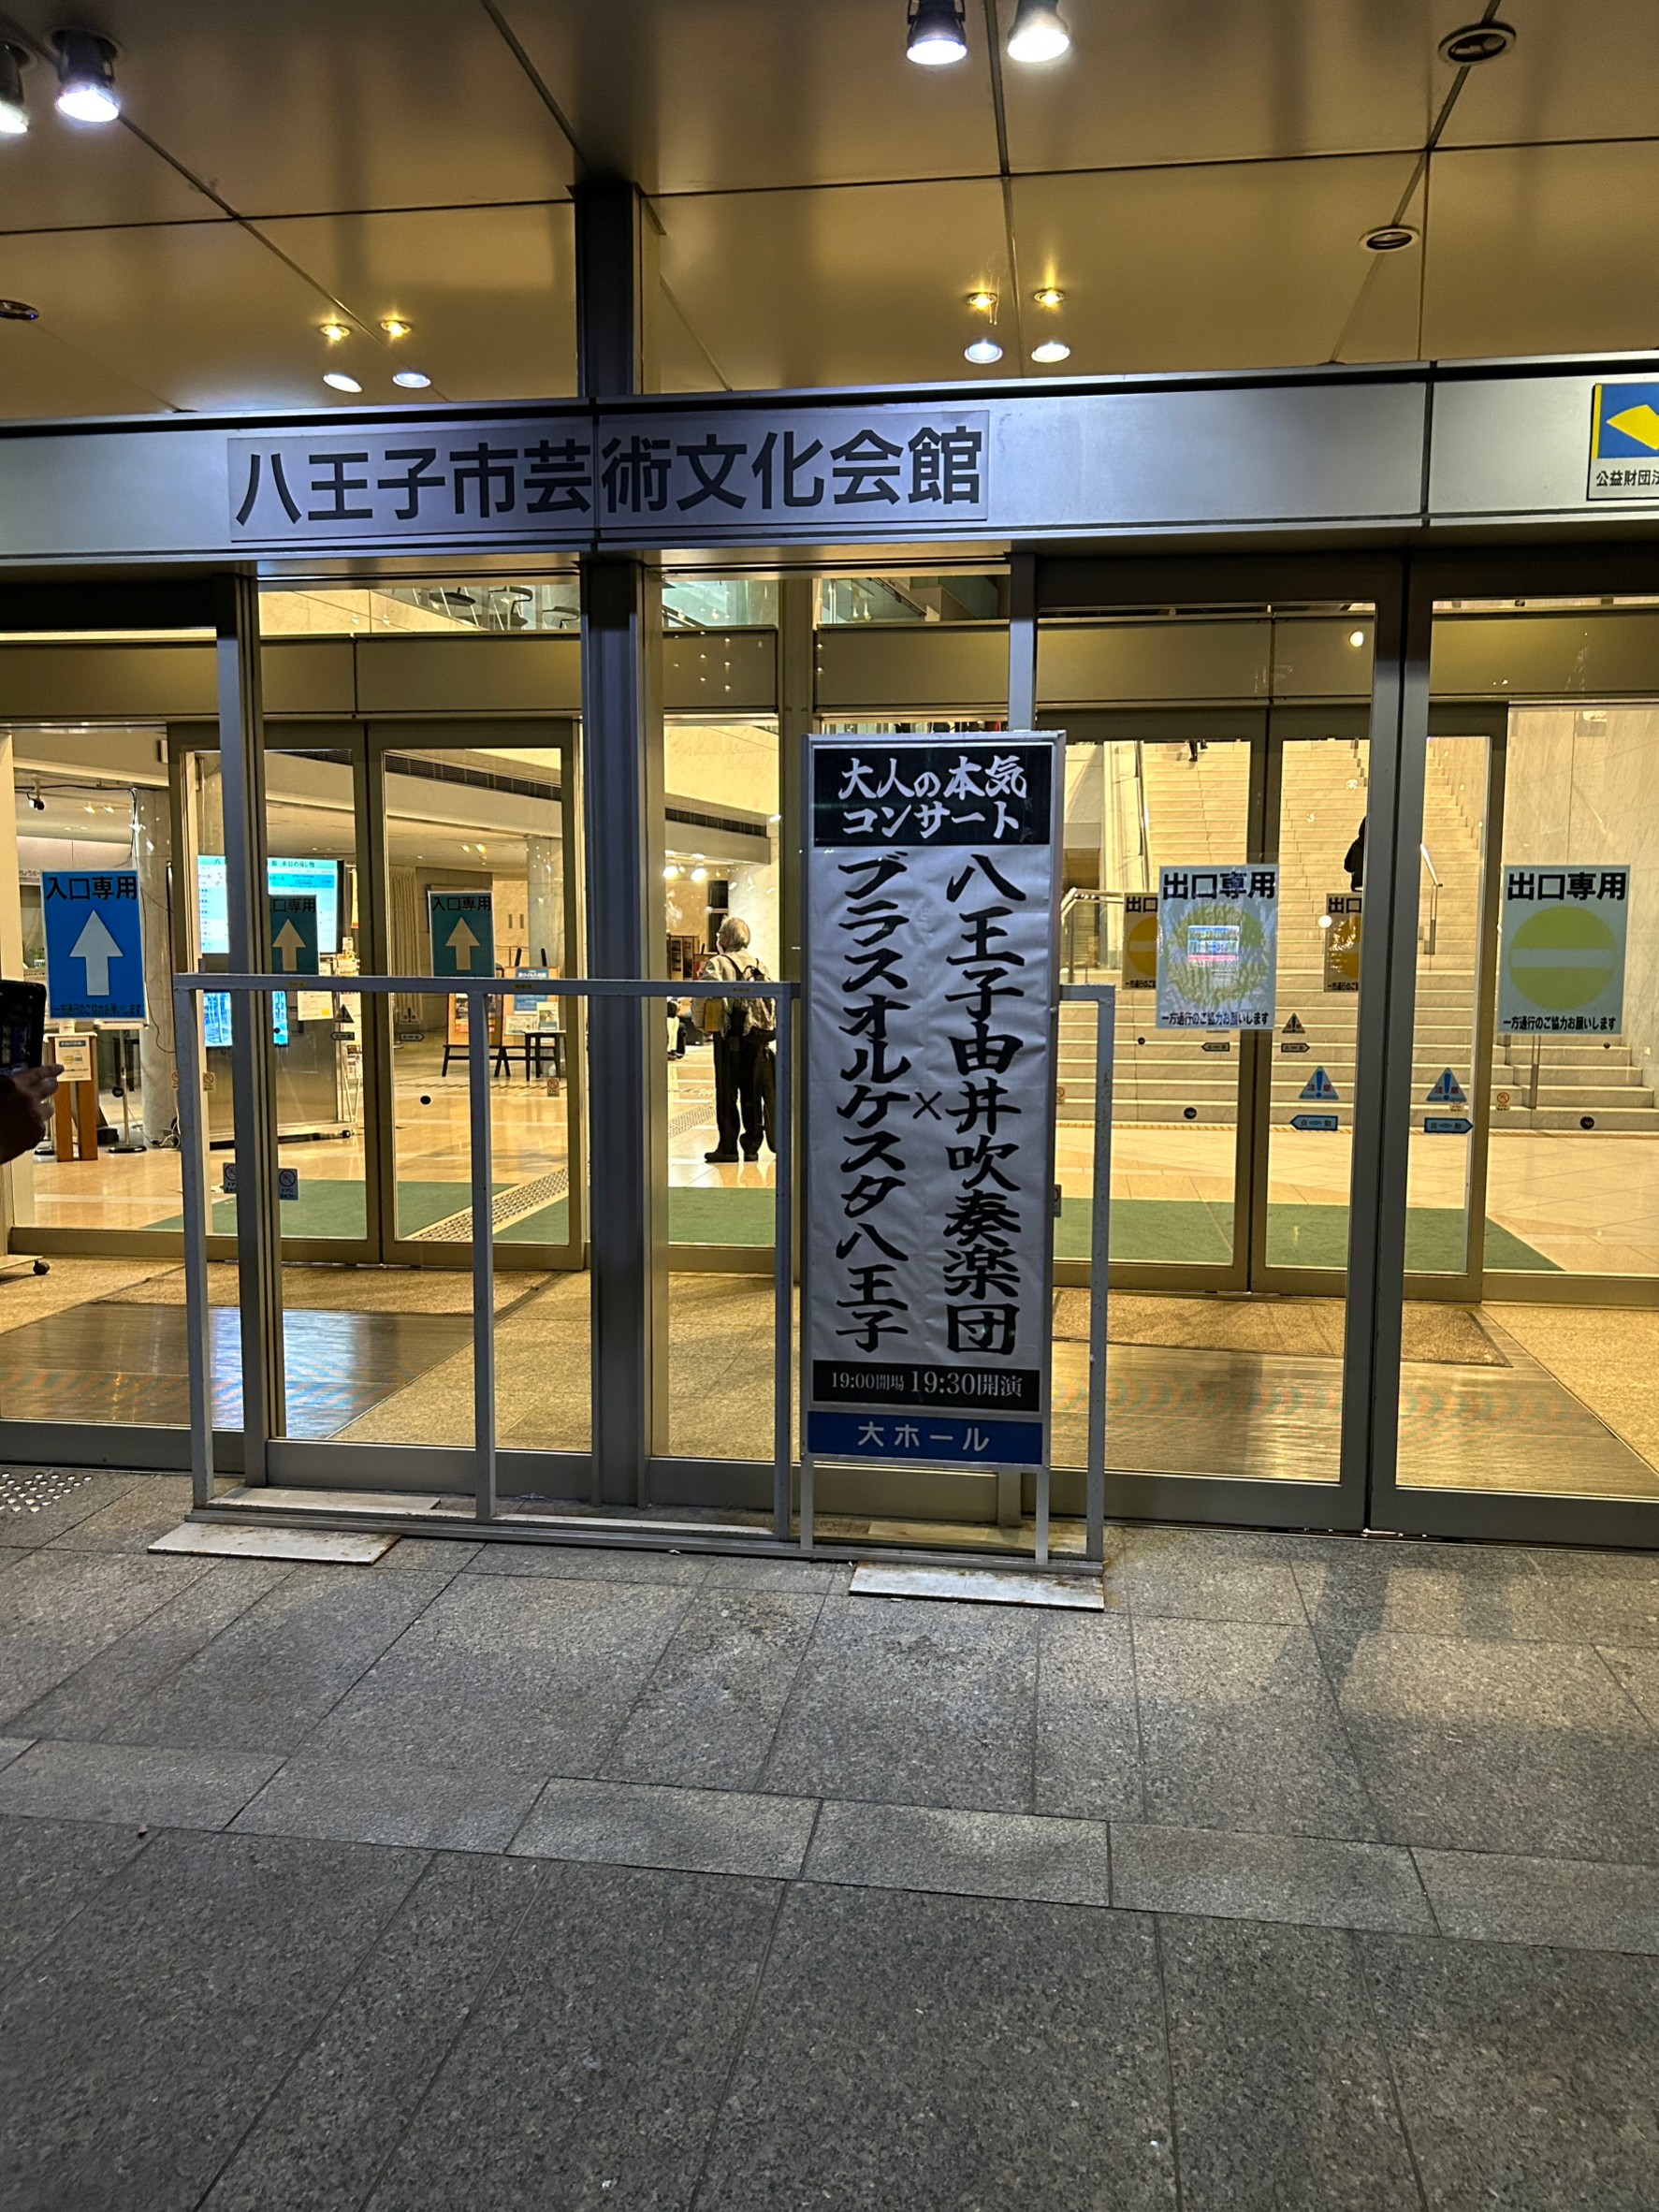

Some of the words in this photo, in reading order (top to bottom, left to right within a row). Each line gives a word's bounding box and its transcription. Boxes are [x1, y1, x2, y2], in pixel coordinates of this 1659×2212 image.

[235, 425, 983, 527] 八王子市芸術文化会館
[837, 755, 1027, 800] 大人の本気
[842, 801, 1020, 839] コンサート
[45, 876, 138, 900] 入口専用
[1163, 871, 1275, 900] 出口専用
[1507, 872, 1626, 900] 出口専用
[269, 898, 316, 912] 口専用
[432, 896, 491, 911] 入口専用
[1126, 896, 1158, 913] 出口
[1328, 896, 1362, 913] 出口
[1161, 1011, 1269, 1026] 一方通行のご協力お願いします
[1503, 1015, 1616, 1030] 一方通行のご協力お願いします
[836, 851, 912, 1353] ブラスオルケスタ八王子
[942, 853, 1027, 1356] 八王子由井吹奏楽団
[832, 1372, 905, 1391] 19:00開場
[910, 1371, 1023, 1397] 19:30開演
[857, 1420, 990, 1451] 大ホール
